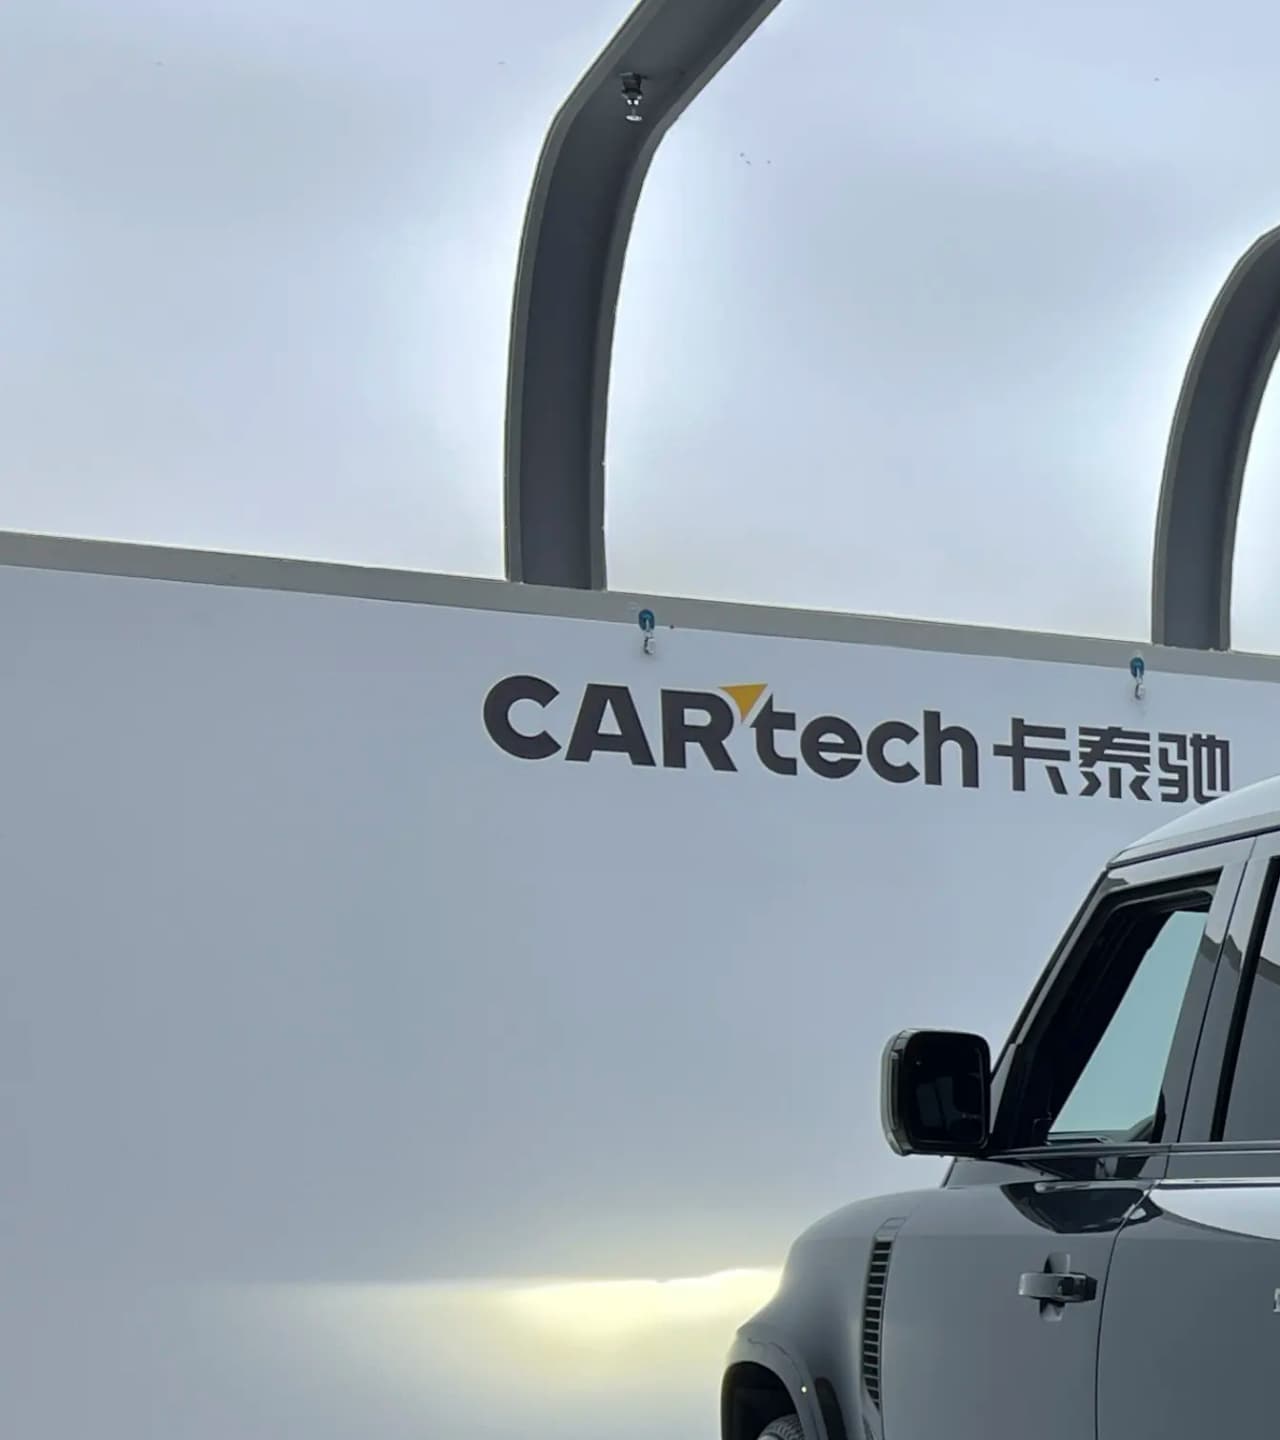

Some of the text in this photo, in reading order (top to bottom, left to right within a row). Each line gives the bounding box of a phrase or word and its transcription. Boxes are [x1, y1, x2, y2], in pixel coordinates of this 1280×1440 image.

[482, 674, 1231, 805] CARtech 卡泰驰
